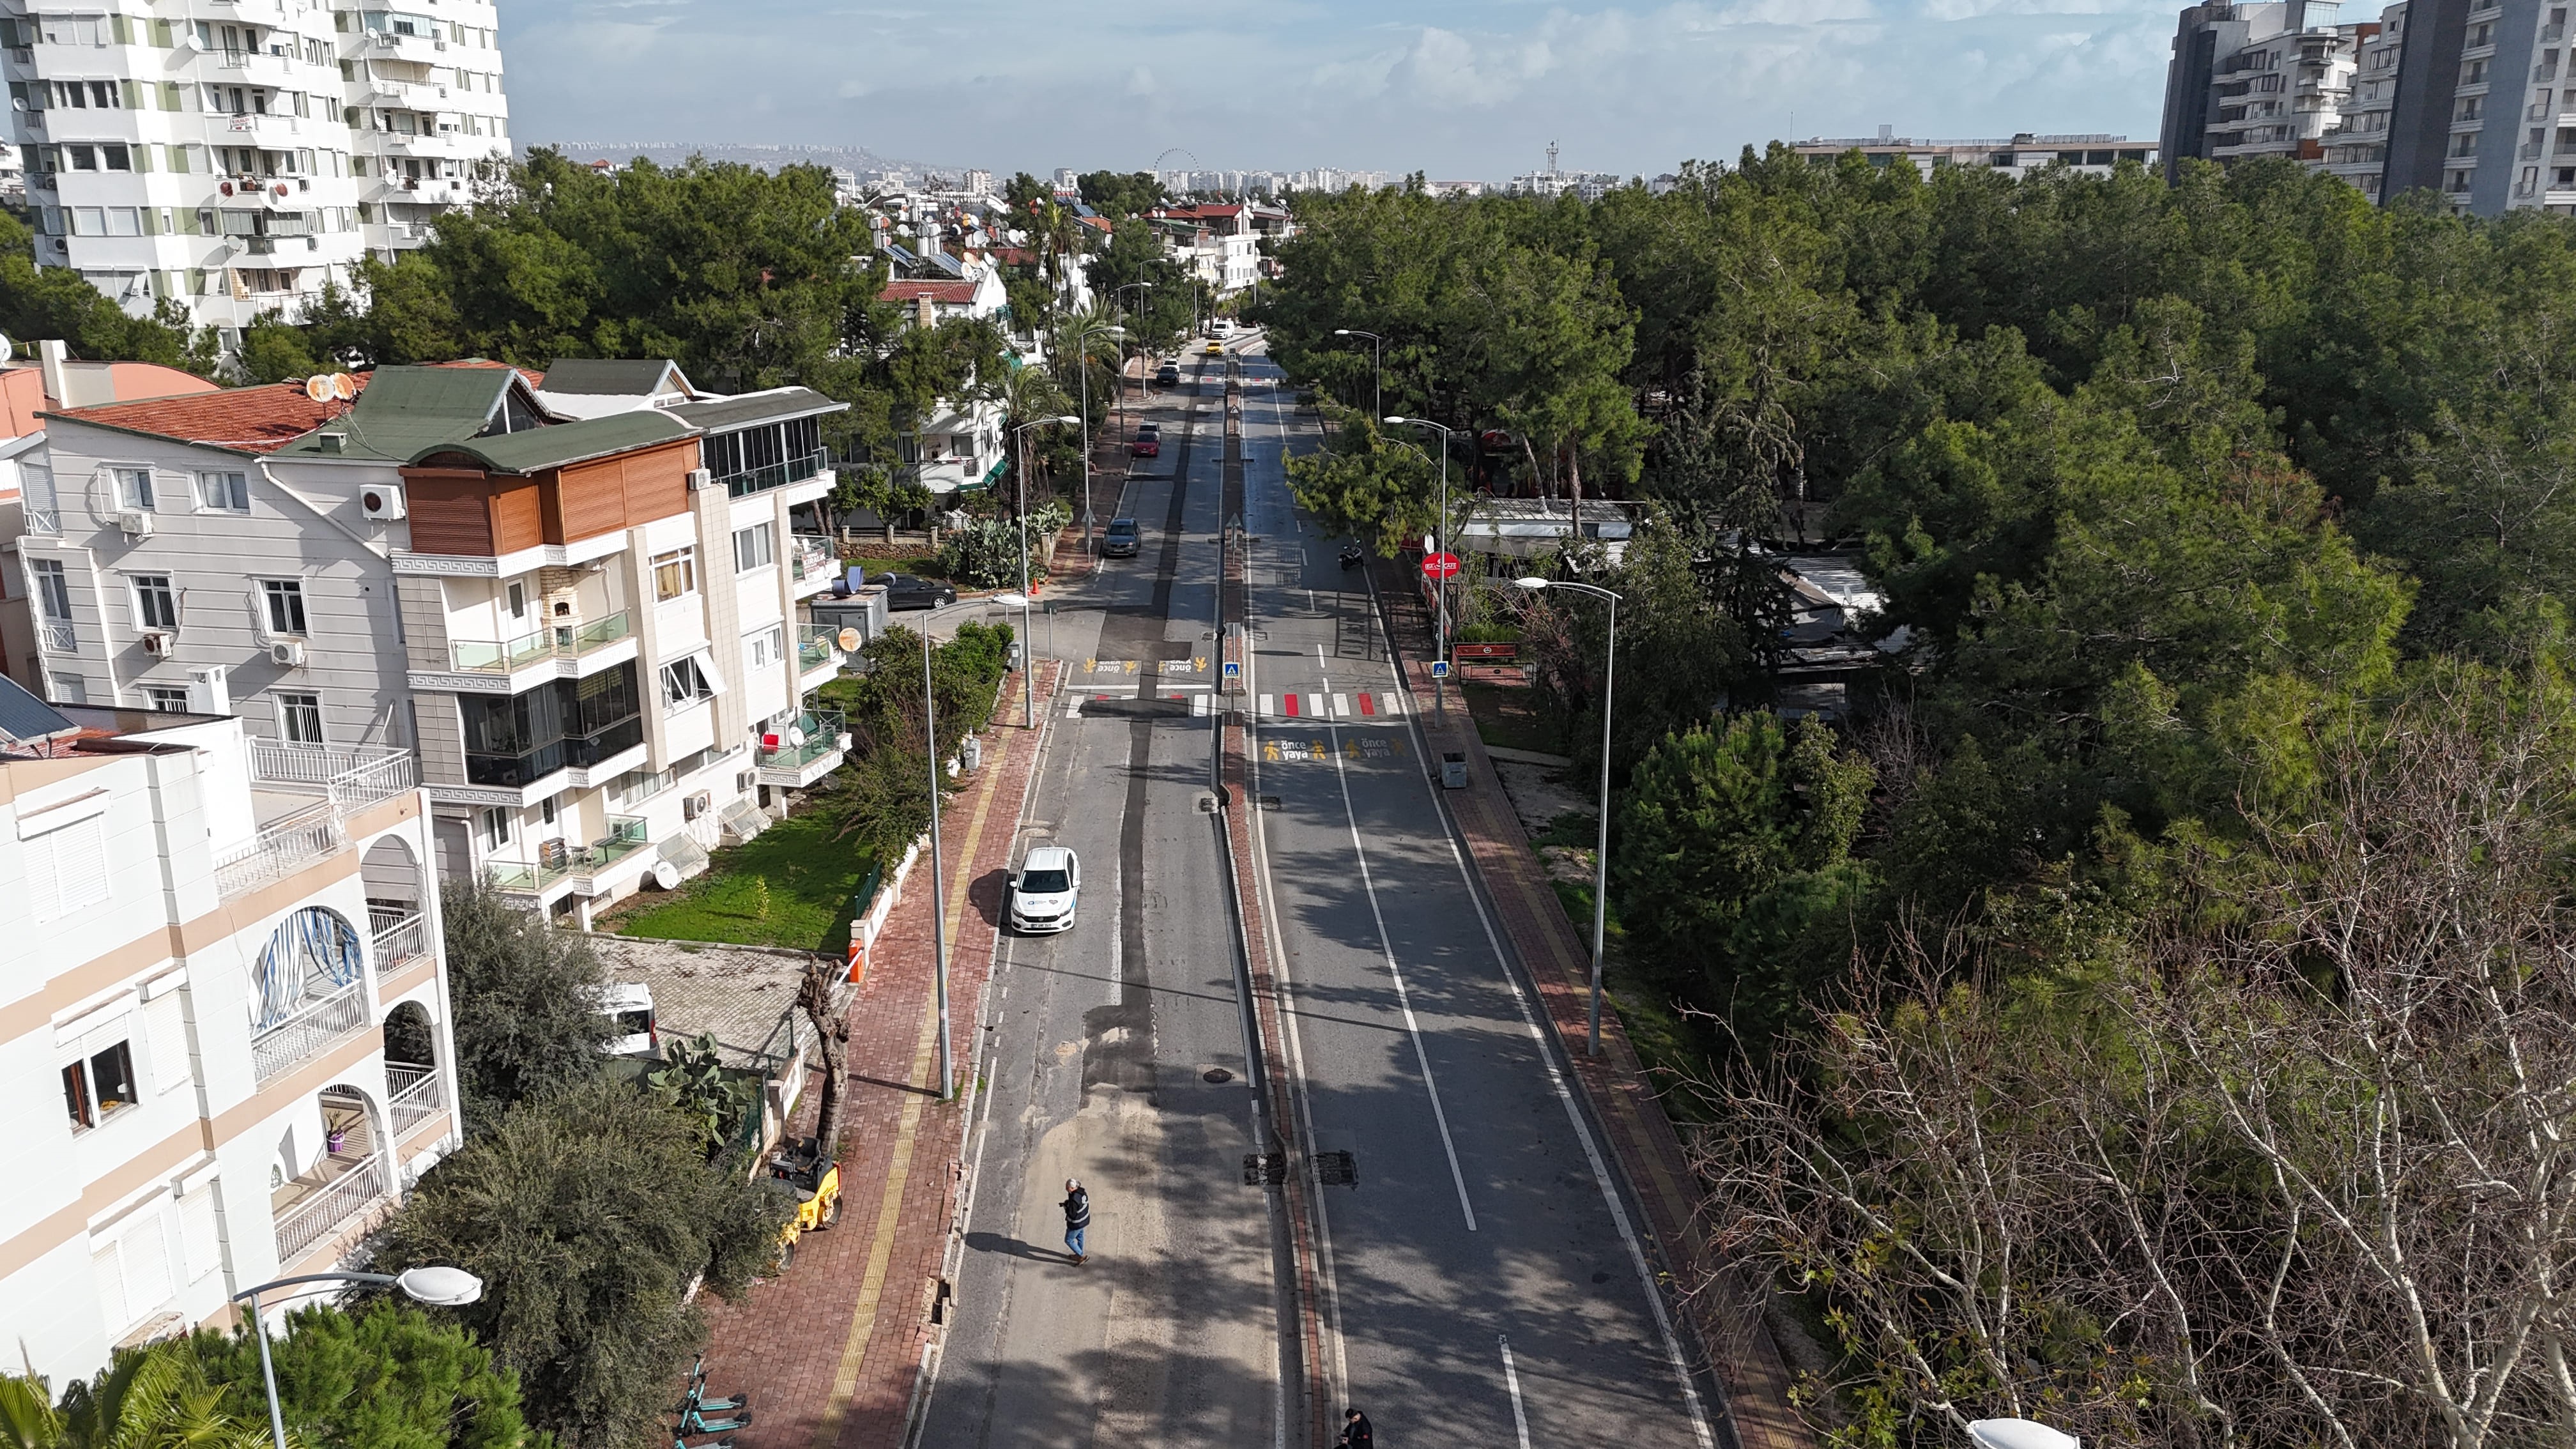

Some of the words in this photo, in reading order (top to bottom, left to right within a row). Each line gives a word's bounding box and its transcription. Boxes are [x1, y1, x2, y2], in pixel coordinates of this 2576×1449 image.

[1098, 665, 1120, 673] önce
[1170, 664, 1192, 673] önce
[1280, 740, 1307, 750] önce
[1361, 738, 1387, 747] önce
[1282, 750, 1308, 760] yaya
[1364, 748, 1391, 758] yaya
